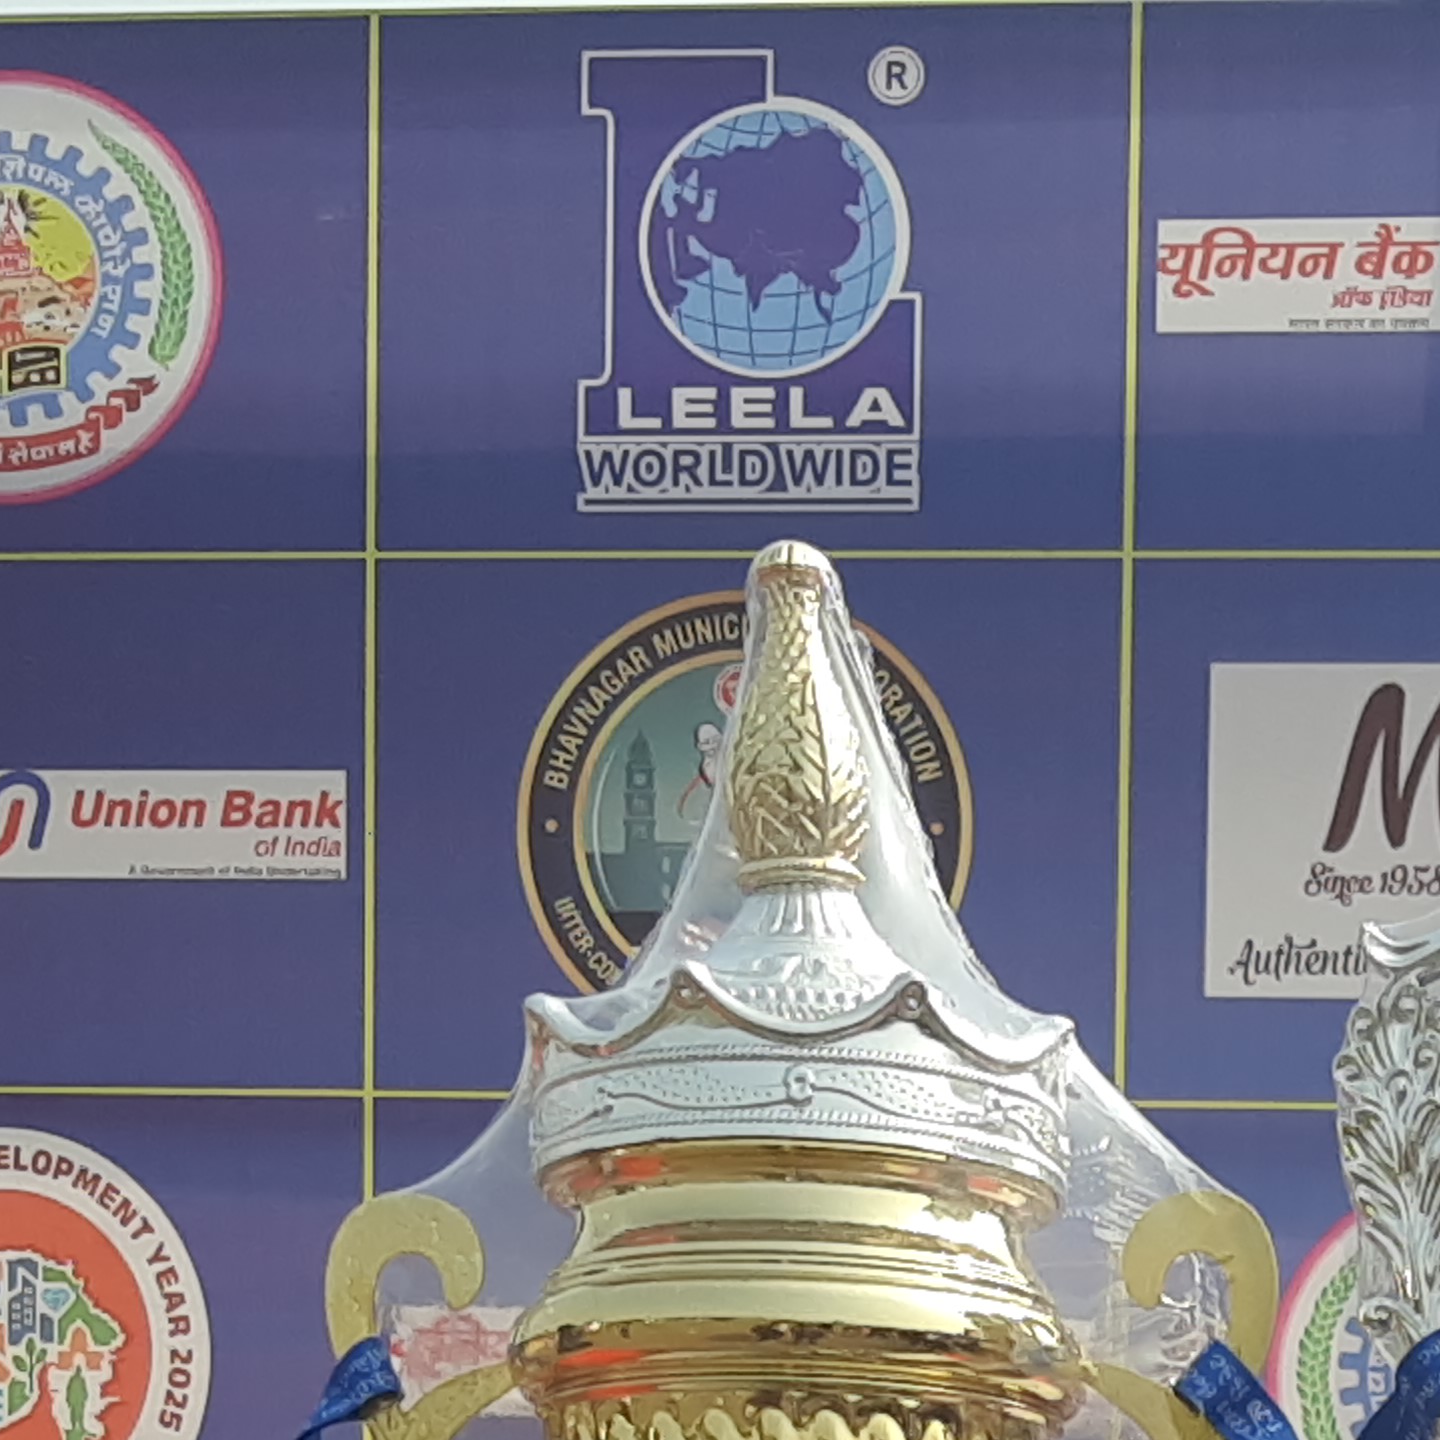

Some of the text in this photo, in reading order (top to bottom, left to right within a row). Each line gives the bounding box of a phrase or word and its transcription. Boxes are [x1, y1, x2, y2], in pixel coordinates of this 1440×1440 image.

[1158, 224, 1340, 296] यूनियन
[617, 385, 906, 429] LEELA
[584, 447, 915, 490] WORLD WIDE
[544, 612, 944, 791] BHAVNAGAR MUNICI ORATION
[71, 789, 343, 829] Union Bank
[254, 836, 342, 857] of India
[1304, 861, 1376, 906] Since
[1228, 934, 1367, 985] Authenti
[146, 1242, 194, 1338] YEAR
[159, 1348, 194, 1434] 2025
